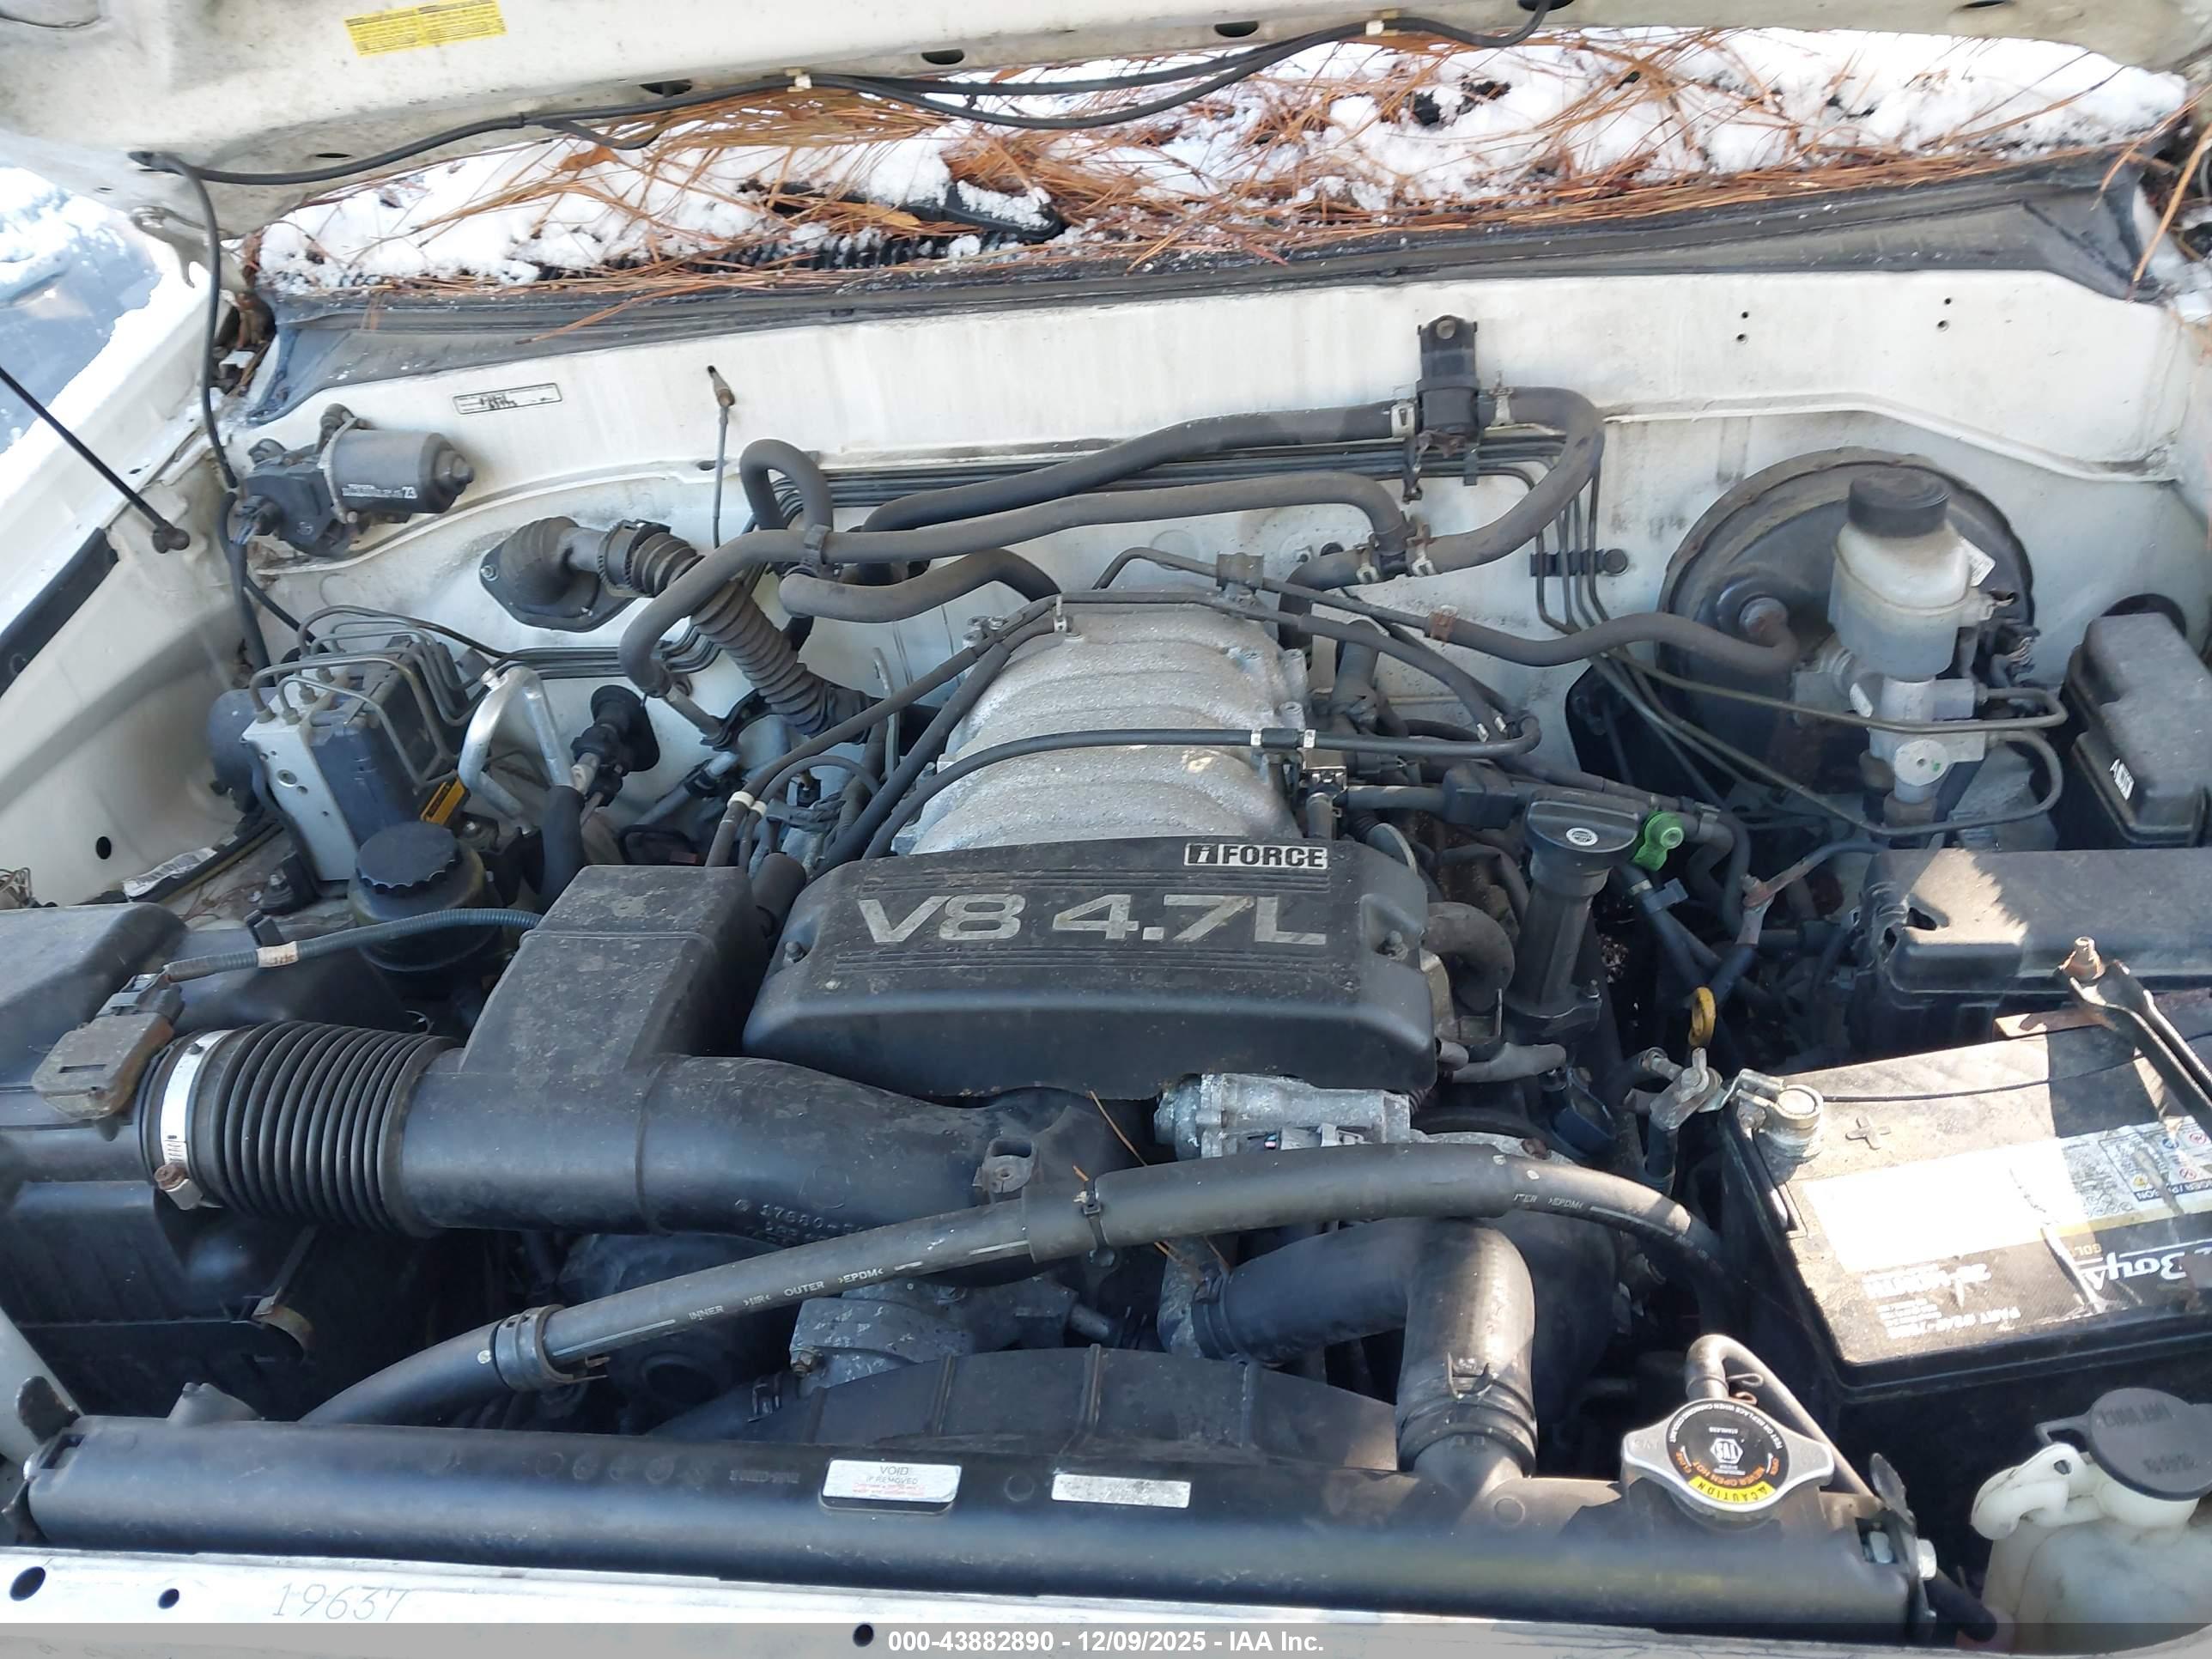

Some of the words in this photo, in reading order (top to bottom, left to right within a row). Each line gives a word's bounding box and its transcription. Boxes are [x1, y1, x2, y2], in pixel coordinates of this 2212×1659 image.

[1222, 845, 1325, 868] FORCE
[859, 893, 1026, 944] V8
[1052, 893, 1327, 945] 4.7L
[688, 1304, 725, 1321] INNER
[783, 1280, 825, 1297] OUTER
[1713, 1402, 1735, 1412] WHEN
[1735, 1407, 1766, 1426] REPLACE
[1763, 1424, 1774, 1435] OR
[879, 1465, 909, 1476] VOID
[1692, 1461, 1711, 1477] HOT
[1711, 1474, 1738, 1486] OPEN
[1697, 1482, 1759, 1503] CAUTION
[272, 1582, 410, 1622] 19637
